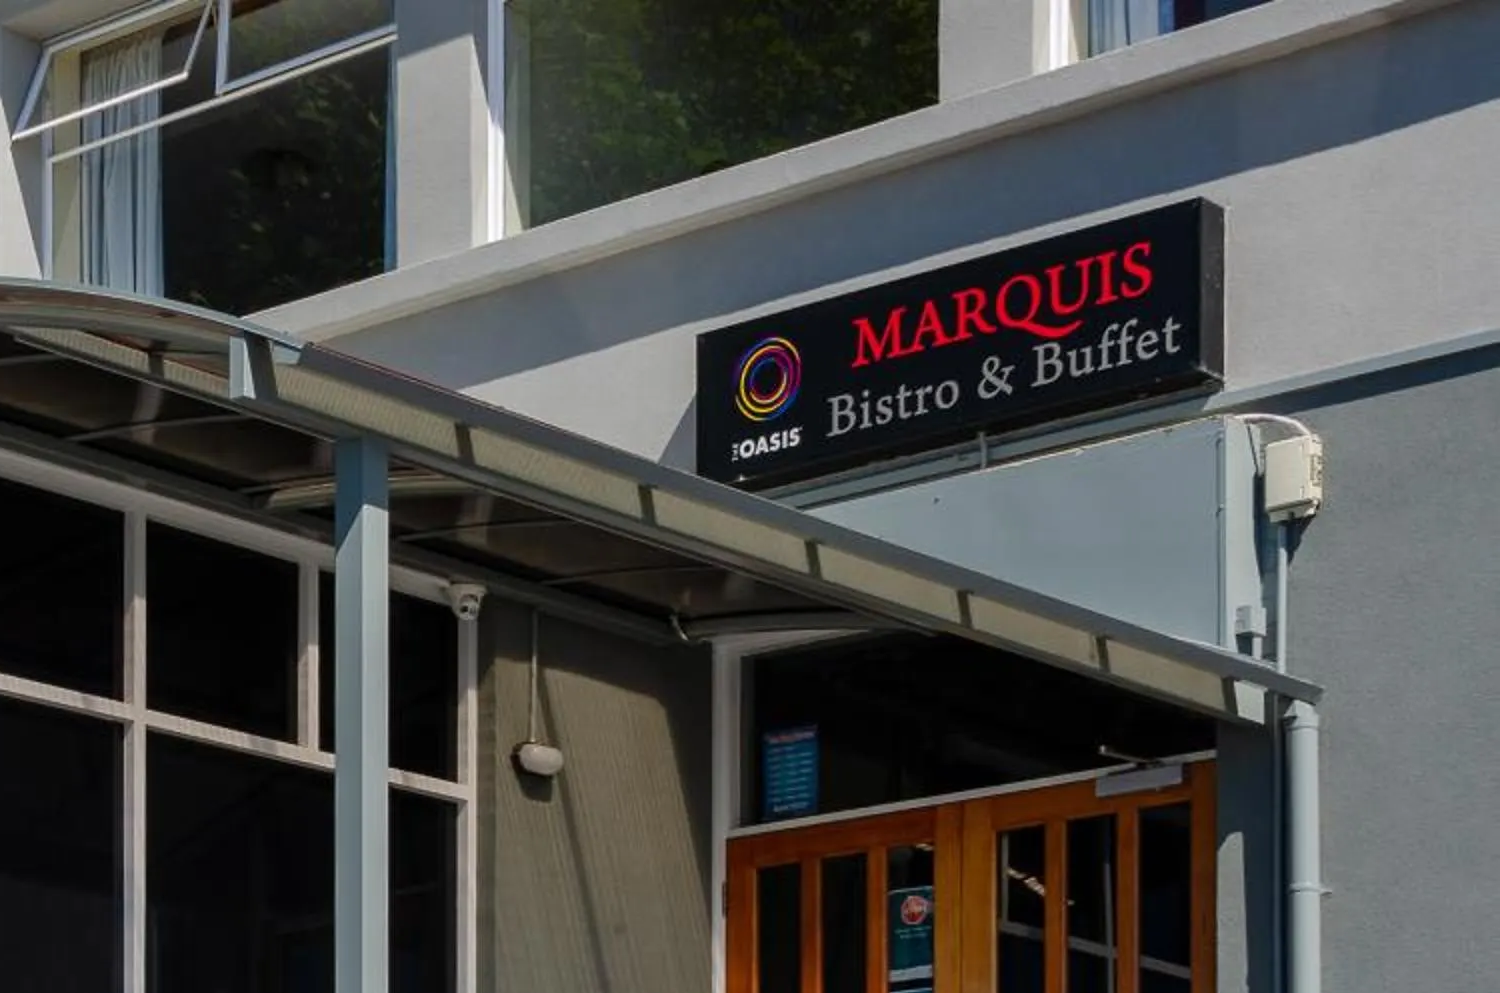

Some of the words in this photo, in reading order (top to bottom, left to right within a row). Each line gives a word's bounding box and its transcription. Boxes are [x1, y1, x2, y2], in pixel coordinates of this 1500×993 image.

[850, 242, 1153, 367] MARQUIS
[826, 379, 959, 437] Bistro
[977, 357, 1014, 399] &
[1031, 316, 1181, 386] Buffet
[740, 427, 801, 459] OASIS
